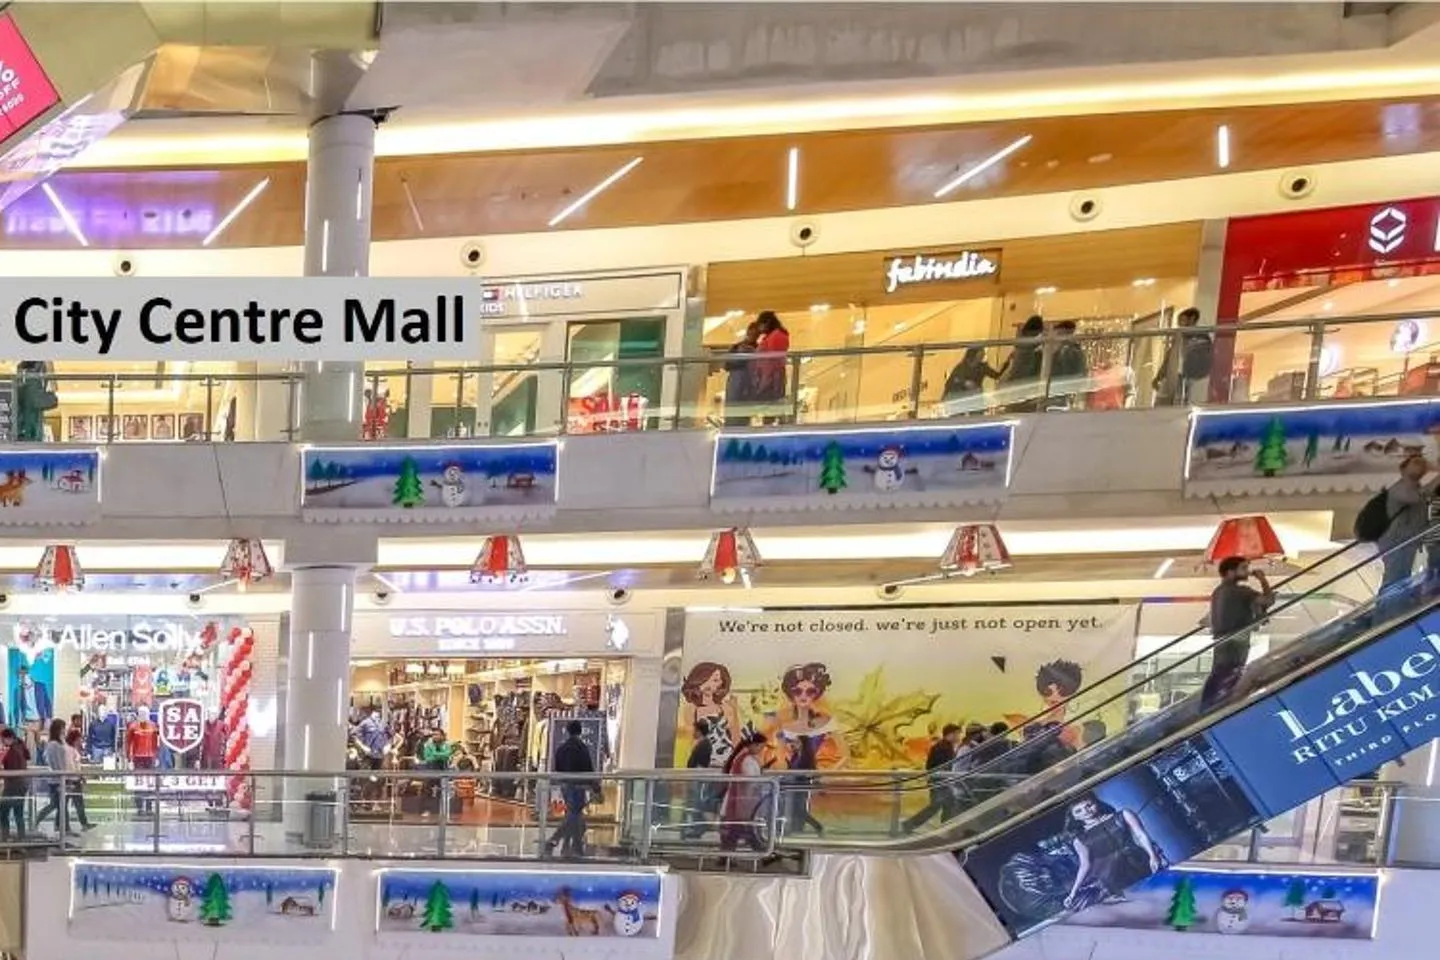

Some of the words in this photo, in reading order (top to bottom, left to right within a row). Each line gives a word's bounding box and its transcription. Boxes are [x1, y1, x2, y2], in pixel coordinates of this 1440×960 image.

[886, 251, 996, 293] fabindia
[60, 622, 127, 650] Allen
[435, 617, 497, 636] POLO
[718, 620, 769, 633] We're
[774, 620, 805, 632] not
[876, 618, 926, 631] we're
[929, 617, 967, 634] just
[973, 618, 1008, 630] not
[1013, 617, 1062, 633] open
[1292, 717, 1369, 765] RITU
[1333, 734, 1392, 766] THIRD
